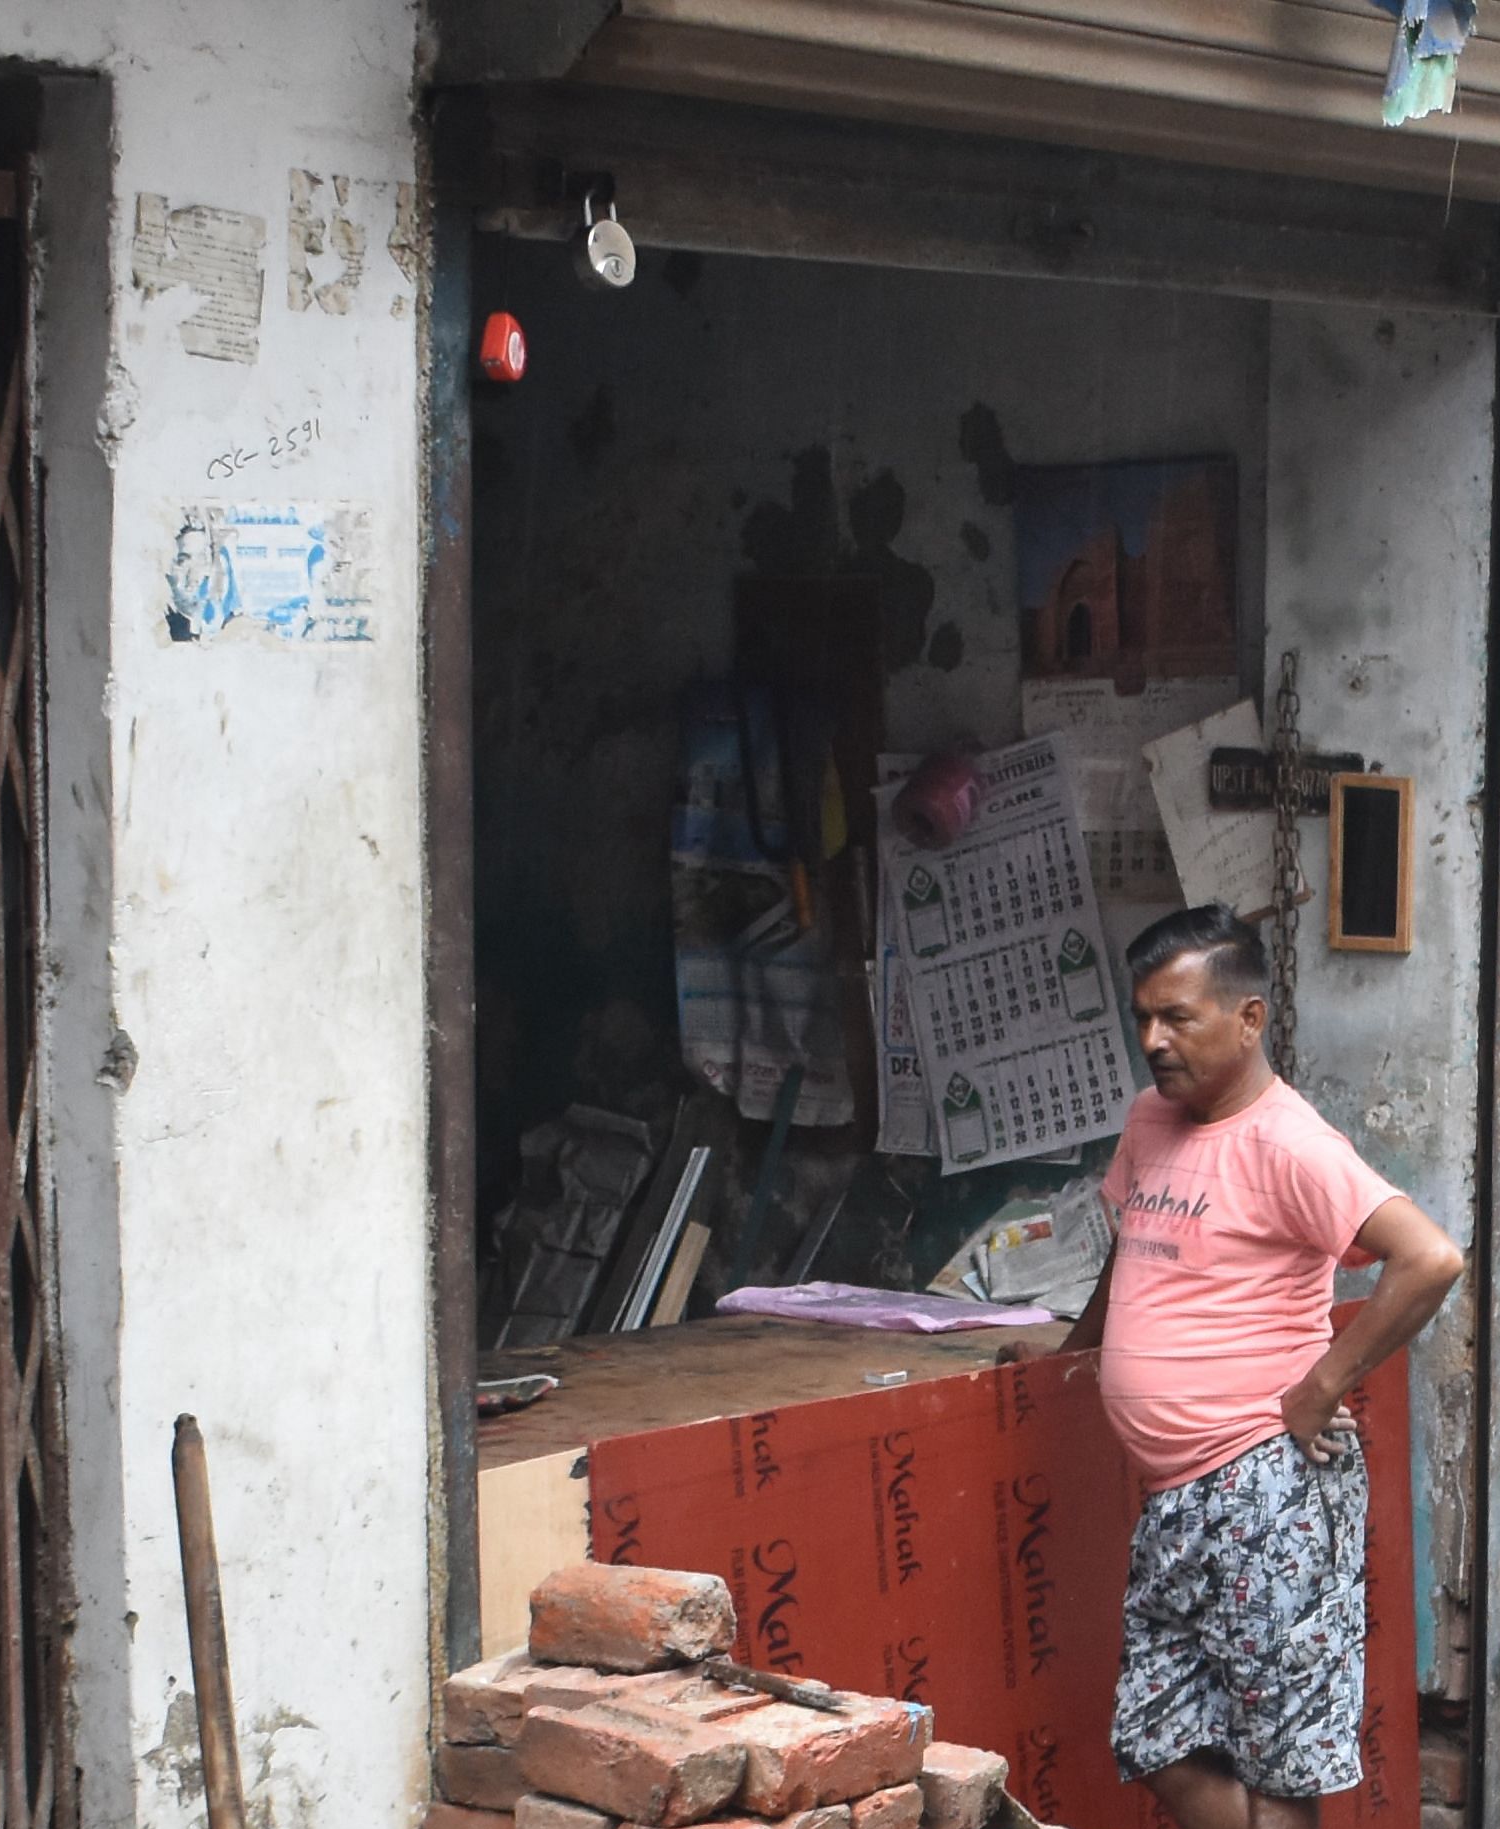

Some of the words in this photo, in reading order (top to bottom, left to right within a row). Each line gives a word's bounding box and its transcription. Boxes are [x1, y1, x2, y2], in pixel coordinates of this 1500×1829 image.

[268, 418, 323, 457] 2591
[987, 787, 1045, 814] CARE
[752, 1411, 781, 1491] hak
[885, 1431, 923, 1587] Mahak
[731, 1548, 745, 1580] FILM
[1013, 1473, 1060, 1678] Mahak
[736, 1618, 752, 1666] SHUTT
[753, 1539, 804, 1674] Mah
[1003, 1629, 1017, 1689] PLYWOOD
[1030, 1724, 1060, 1824] Mah
[1369, 1686, 1391, 1819] Mahak
